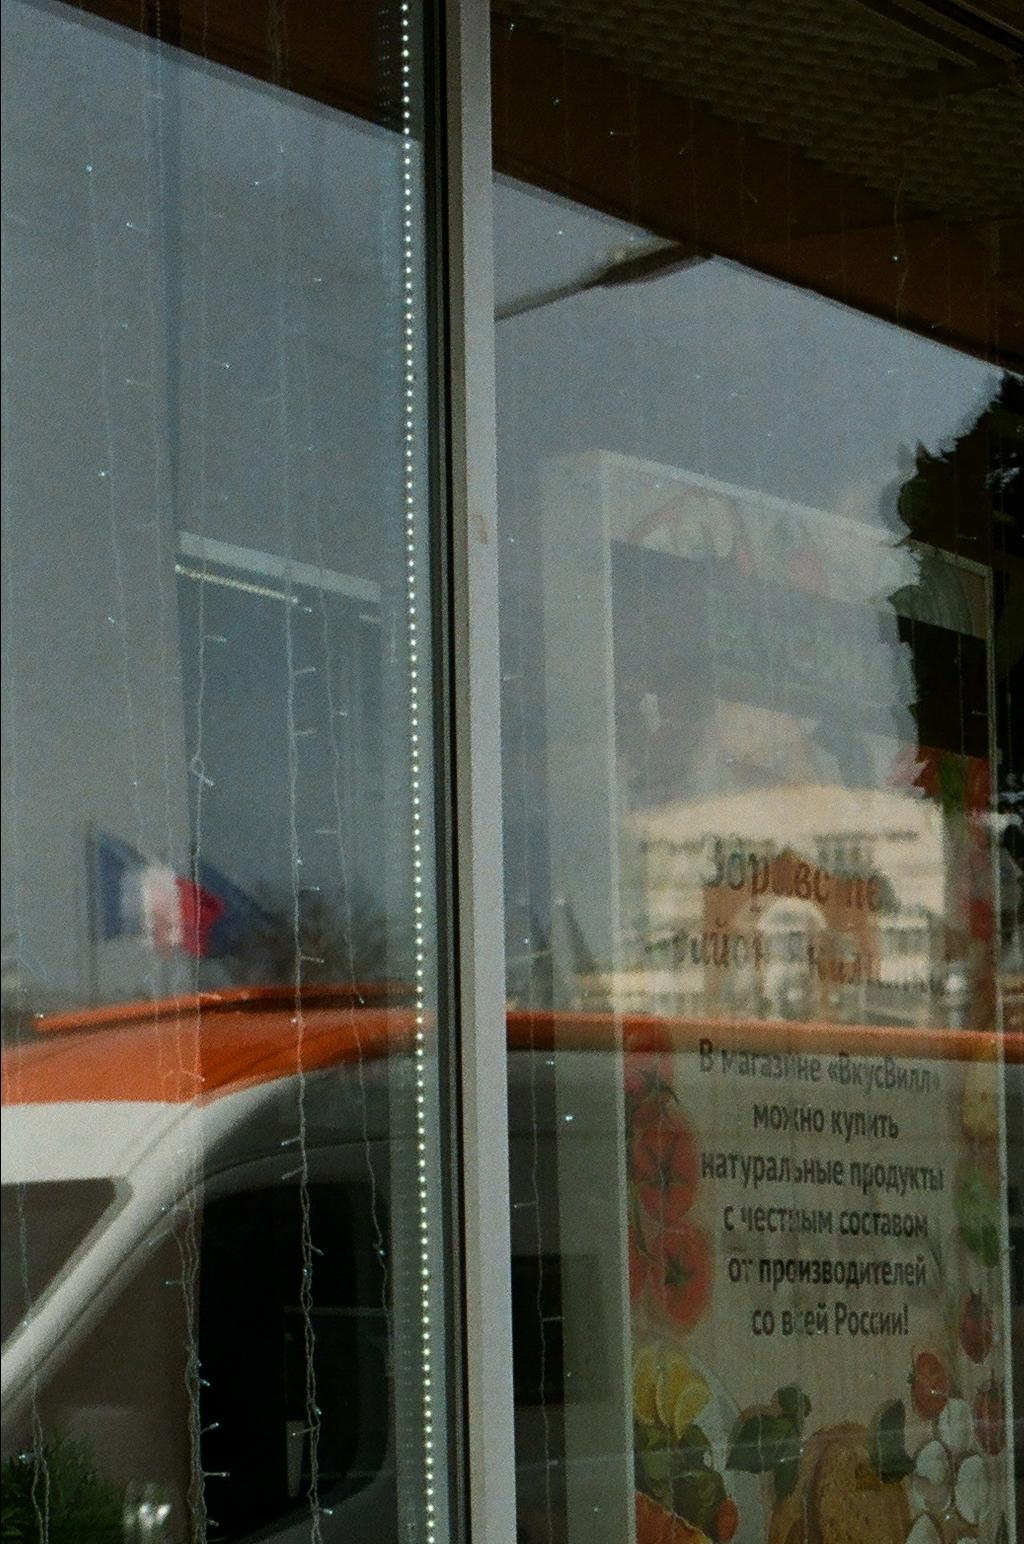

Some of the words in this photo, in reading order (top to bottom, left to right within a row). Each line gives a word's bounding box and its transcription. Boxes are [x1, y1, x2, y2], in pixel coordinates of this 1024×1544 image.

[699, 1039, 714, 1073] В
[753, 1104, 825, 1133] можно
[831, 1110, 899, 1143] купить
[701, 1152, 843, 1189] натуральные
[849, 1161, 944, 1196] продукты
[723, 1206, 735, 1232] с
[740, 1207, 832, 1235] честным
[839, 1211, 928, 1238] составом
[728, 1258, 754, 1283] от
[758, 1252, 927, 1292] производителей
[752, 1310, 775, 1336] со
[834, 1302, 910, 1336] России!
